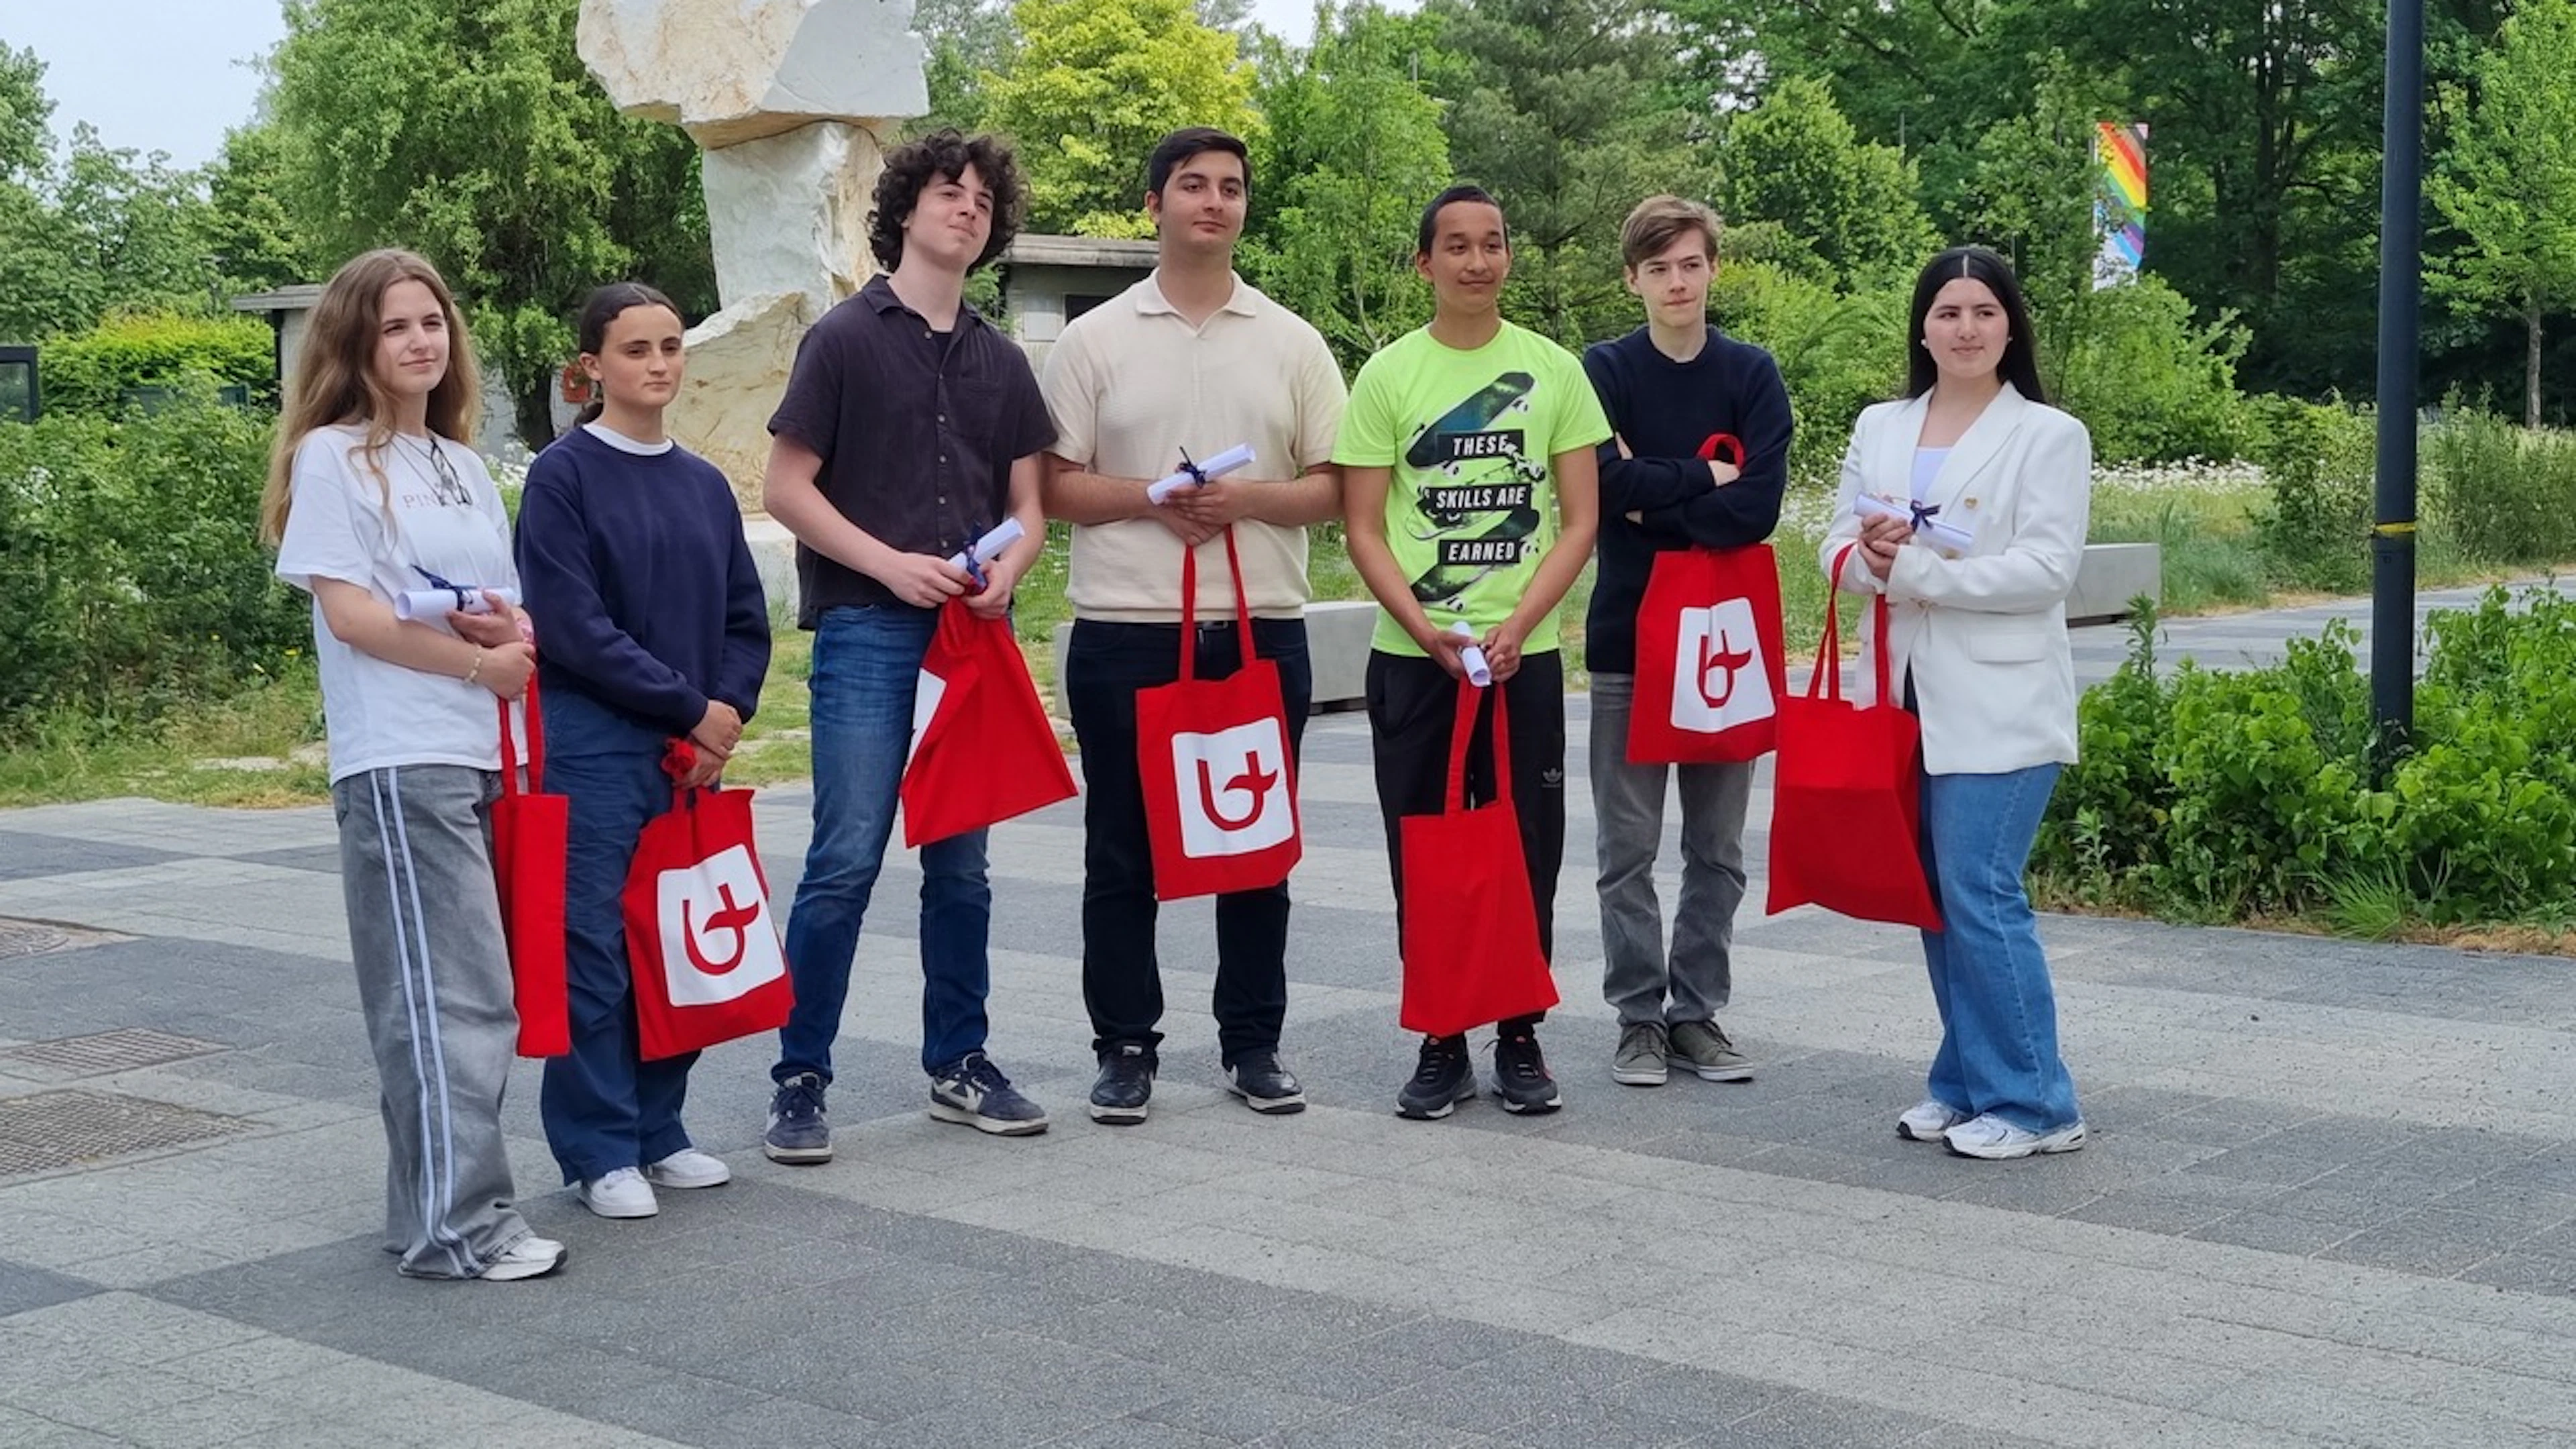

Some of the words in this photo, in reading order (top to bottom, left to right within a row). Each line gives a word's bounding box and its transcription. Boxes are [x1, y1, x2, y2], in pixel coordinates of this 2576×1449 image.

[1452, 434, 1510, 456] THESE
[1436, 488, 1491, 509] SKILLS
[1496, 486, 1527, 507] ARE
[1448, 541, 1516, 562] EARNED
